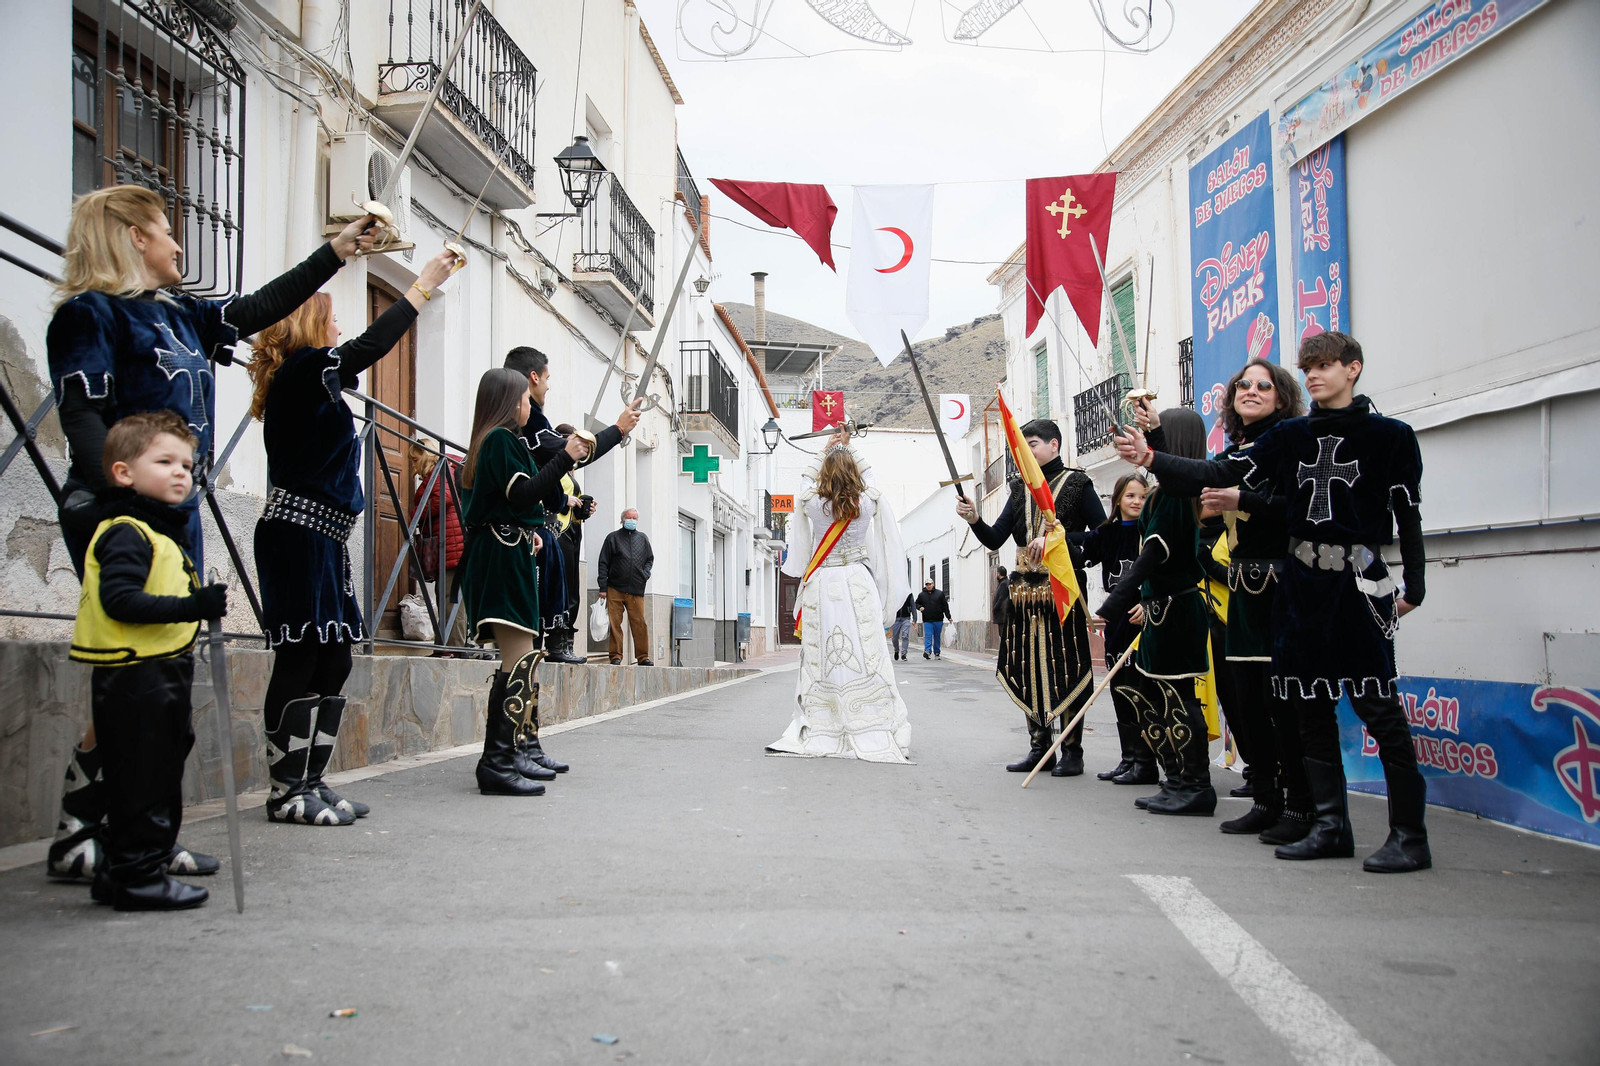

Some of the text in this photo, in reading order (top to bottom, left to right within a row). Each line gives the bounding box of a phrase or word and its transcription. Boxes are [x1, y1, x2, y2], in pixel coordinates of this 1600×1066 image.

[1379, 1, 1498, 99] DE JUEGOS
[1195, 162, 1266, 228] DE JUEGOS
[1329, 262, 1339, 280] 3
[1206, 271, 1264, 343] PARK
[1202, 391, 1212, 415] 3
[770, 498, 792, 509] SPAR
[1411, 733, 1498, 779] UEGOS
